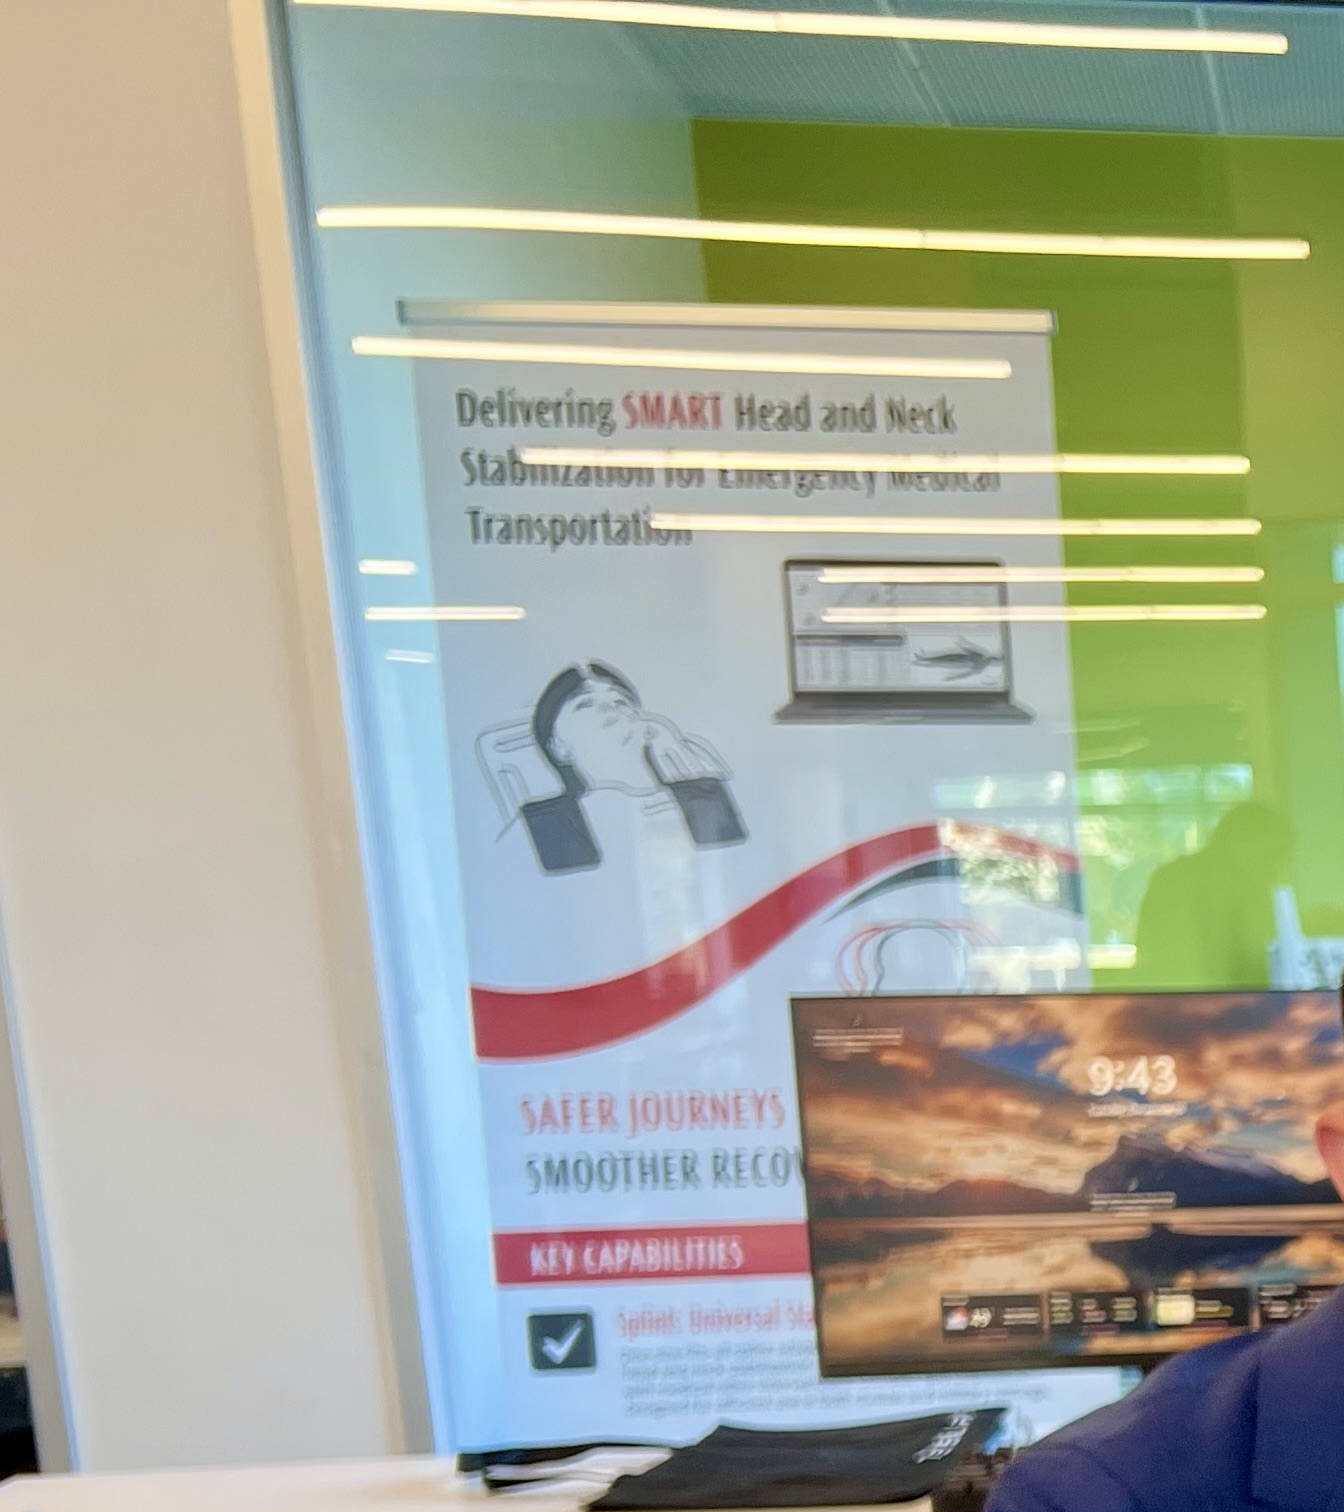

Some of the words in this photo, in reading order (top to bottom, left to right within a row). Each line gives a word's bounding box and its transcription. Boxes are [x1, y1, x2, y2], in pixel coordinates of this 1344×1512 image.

[456, 388, 616, 437] Delivering
[622, 390, 724, 432] SMART
[736, 391, 811, 433] Head
[820, 393, 877, 434] and
[887, 394, 957, 435] Neck
[466, 506, 693, 551] Transportation
[1087, 1054, 1177, 1097] 9:43
[520, 1091, 617, 1136] SAFER
[628, 1087, 786, 1139] JOURNEYS
[525, 1149, 702, 1195] SMOOTHER
[529, 1240, 574, 1276] KEY
[582, 1235, 745, 1275] CAPABILITIES
